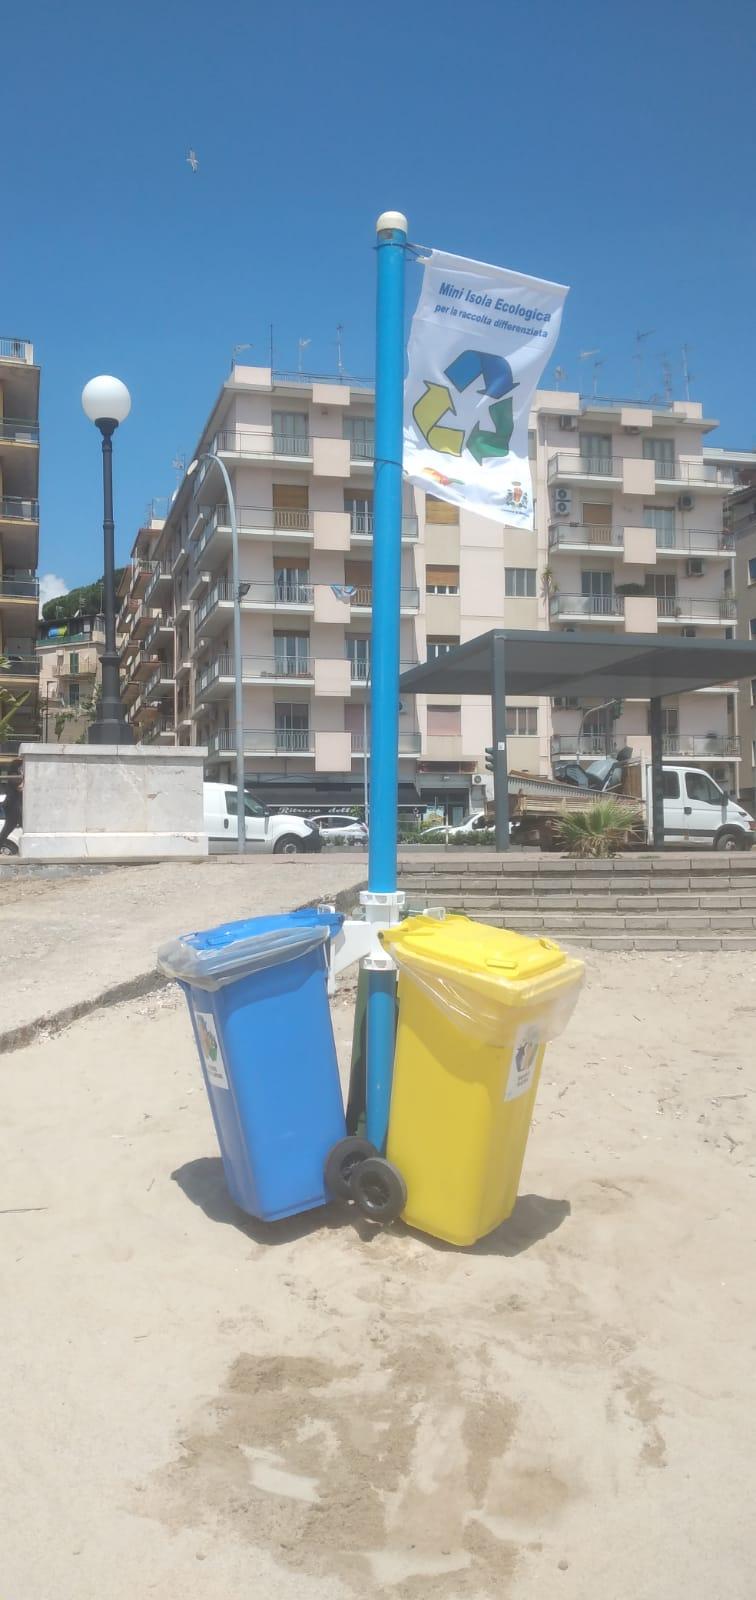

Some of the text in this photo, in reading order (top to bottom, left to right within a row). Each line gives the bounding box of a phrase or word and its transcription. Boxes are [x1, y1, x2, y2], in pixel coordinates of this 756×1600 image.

[438, 282, 551, 322] Mini Isola Ecologica
[434, 304, 549, 338] per la raccolta differenziata
